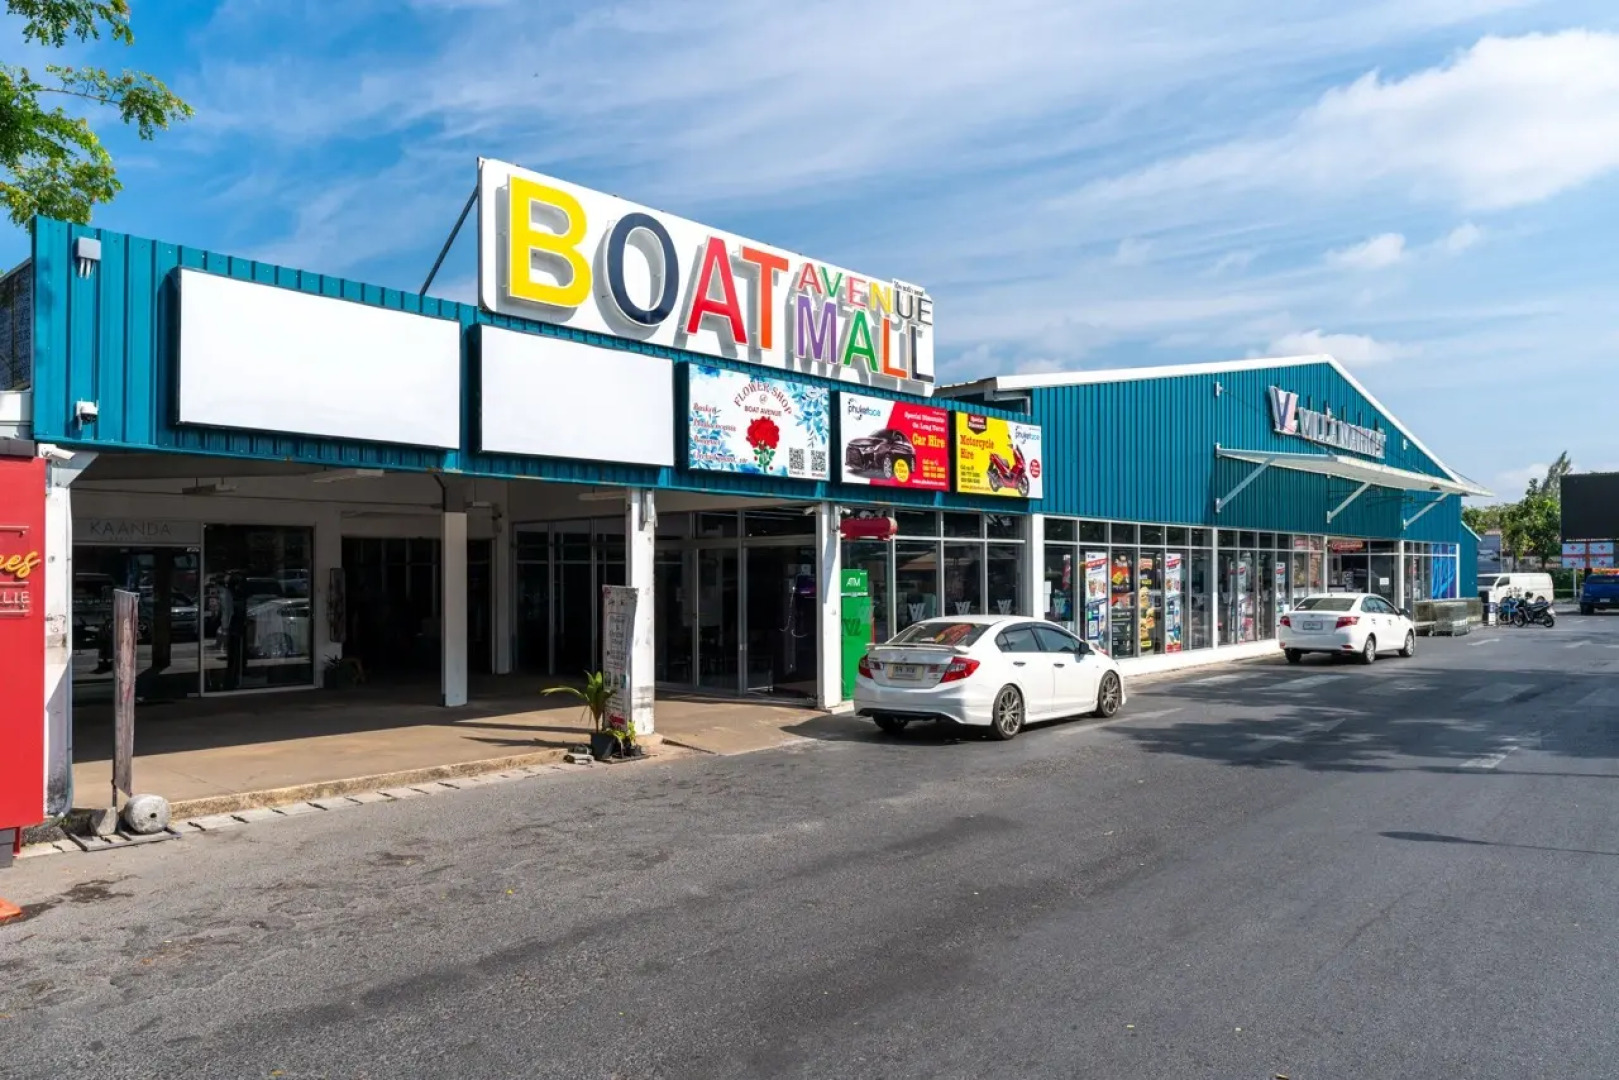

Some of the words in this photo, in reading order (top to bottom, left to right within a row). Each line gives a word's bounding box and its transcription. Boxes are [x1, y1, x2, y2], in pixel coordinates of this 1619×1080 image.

[505, 173, 789, 352] BOAT
[799, 262, 933, 327] AVENUE
[797, 295, 934, 383] MALL
[734, 382, 770, 407] FLOWER
[771, 386, 792, 414] SHOP
[744, 405, 760, 413] BOAT
[760, 408, 782, 417] AVENUE
[912, 432, 927, 446] Car
[928, 435, 946, 449] Hire
[960, 435, 994, 450] Motorcycle
[960, 448, 974, 460] Hire
[91, 520, 172, 536] KAANDA
[846, 577, 861, 587] ATM
